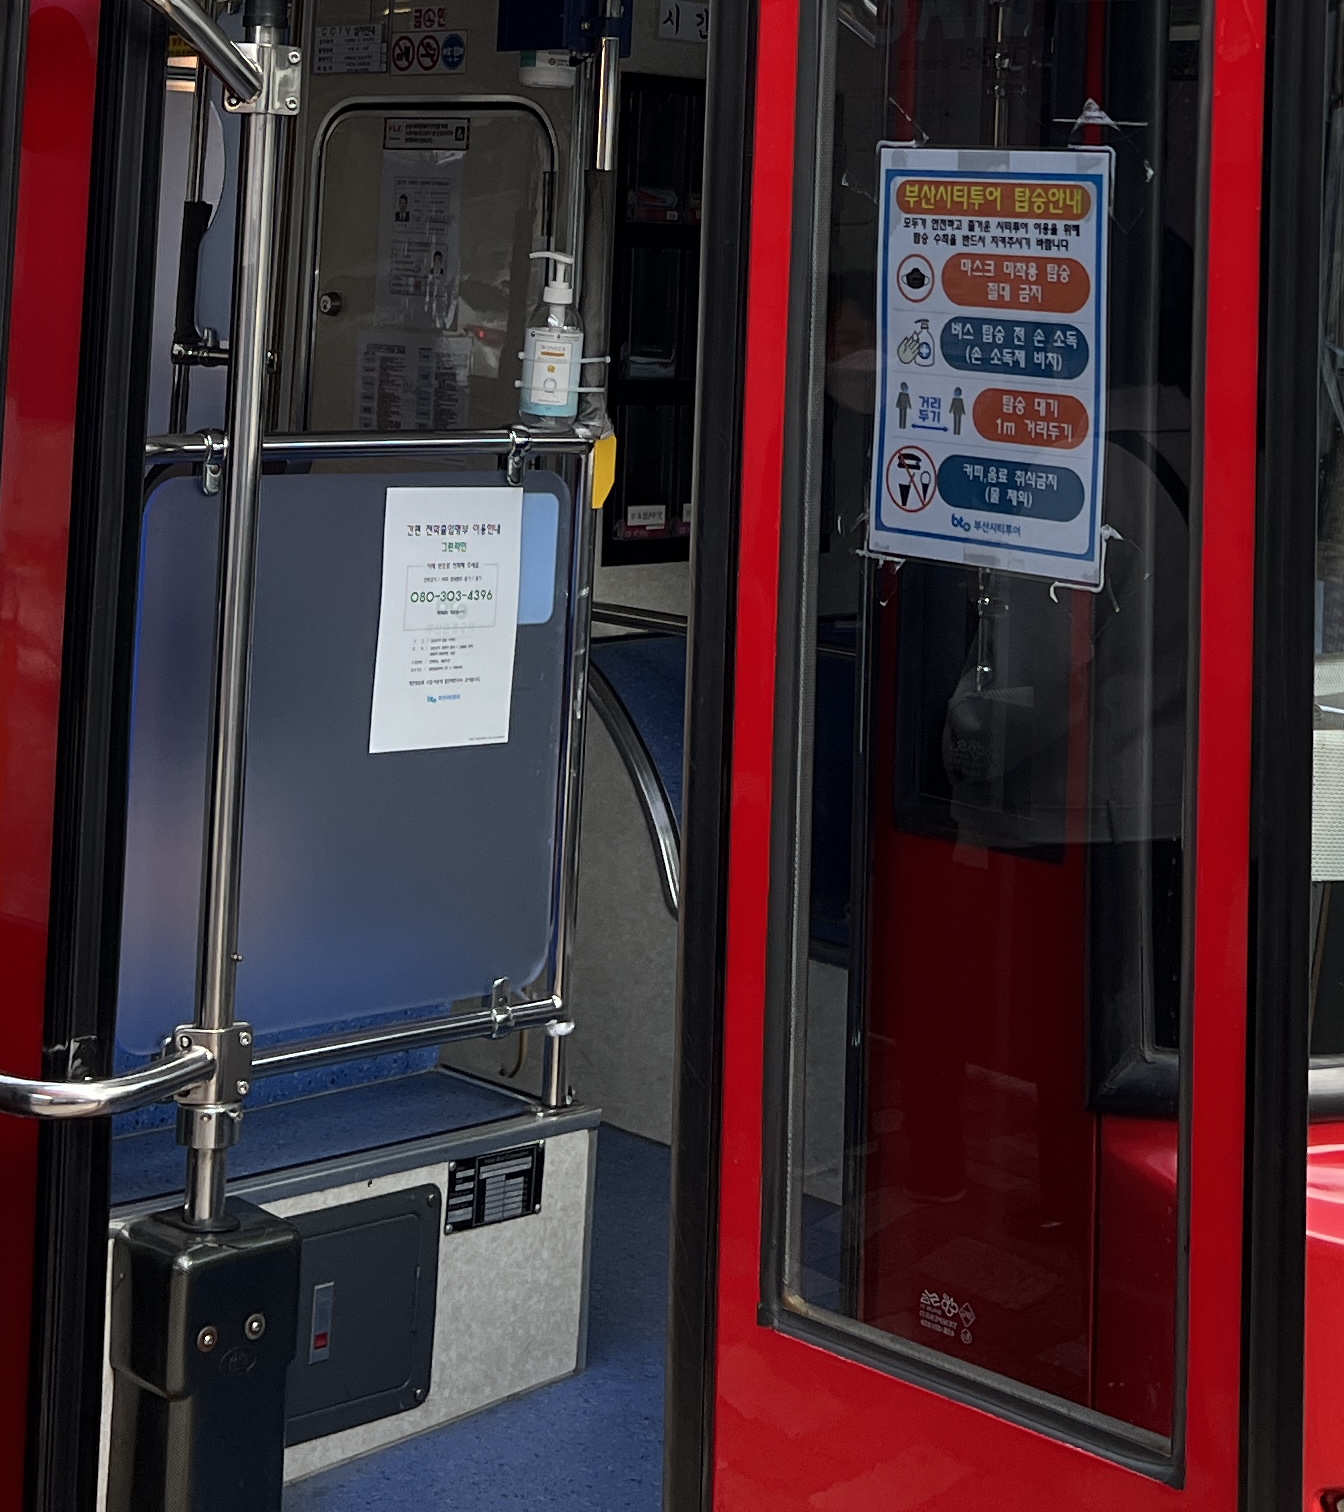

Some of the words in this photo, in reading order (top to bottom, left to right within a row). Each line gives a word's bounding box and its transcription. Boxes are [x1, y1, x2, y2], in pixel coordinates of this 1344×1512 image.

[905, 184, 1002, 211] 부산시티투어
[1014, 187, 1083, 215] 탑승안내
[903, 217, 927, 231] 모두가
[931, 218, 963, 232] 안전하고
[967, 220, 992, 234] 즐거운
[996, 222, 1029, 236] 시티투어
[1033, 223, 1058, 237] 이용을
[1063, 224, 1082, 237] 위해
[913, 232, 929, 245] 탑승
[962, 235, 986, 248] 반드시
[990, 236, 1031, 250] 지켜주시기
[1036, 238, 1069, 252] 바랍니다
[960, 259, 996, 278] 마스크
[1003, 261, 1039, 282] 미착용
[1046, 263, 1071, 284] 탑승
[987, 282, 1011, 301] 절대
[1019, 284, 1042, 303] 금지
[950, 322, 974, 340] 버스
[982, 324, 1005, 344] 탑승
[1013, 326, 1025, 346] 전
[1033, 328, 1046, 348] 손
[1053, 329, 1078, 350] 소독
[965, 345, 982, 366] (손
[990, 346, 1026, 370] 소독제
[1033, 351, 1063, 371] 비치)
[918, 395, 941, 410] 거리
[1002, 394, 1026, 416] 탑승
[1034, 397, 1059, 418] 대기
[918, 409, 941, 424] 두기
[995, 418, 1016, 436] 1m
[1024, 419, 1073, 444] 거리두기
[962, 463, 1009, 485] 커피,음료
[1014, 469, 1058, 491] 취식금지
[984, 486, 1000, 506] (물
[1006, 488, 1034, 509] 제외)
[951, 513, 972, 533] bto
[973, 520, 1022, 539] 부산시티투어
[410, 589, 494, 603] 080-303-4396
